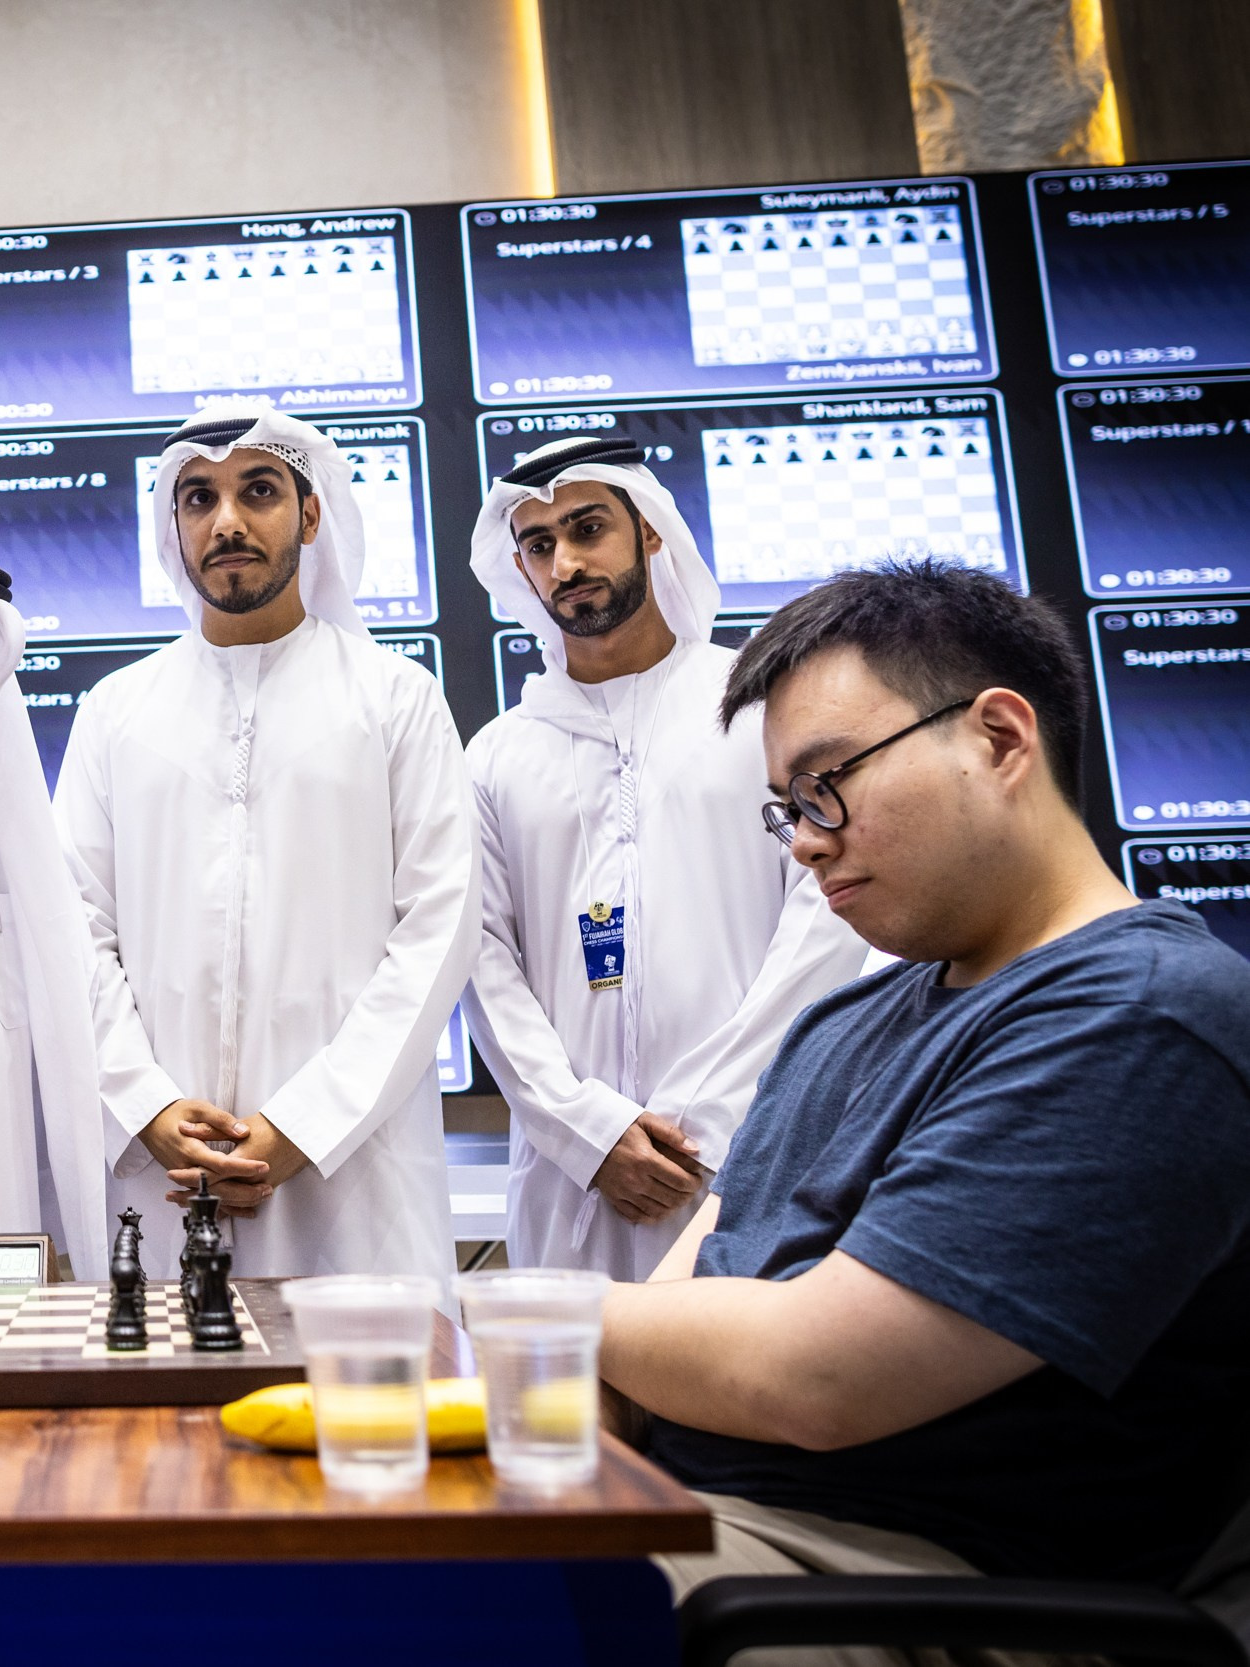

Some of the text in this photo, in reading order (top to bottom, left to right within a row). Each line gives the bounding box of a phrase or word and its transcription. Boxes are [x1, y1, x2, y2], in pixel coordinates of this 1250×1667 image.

[1069, 172, 1169, 191] 01:30:30
[894, 185, 959, 203] Aydin
[501, 204, 596, 223] 01:30:30
[1067, 207, 1193, 227] Superstars
[1212, 203, 1229, 218] 5
[242, 216, 396, 241] Hong, Andrew
[497, 237, 619, 258] Superstars
[635, 235, 652, 251] 4
[84, 266, 98, 280] 3
[1094, 346, 1197, 365] 01:30:30
[932, 358, 982, 373] Ivan
[514, 374, 612, 392] 01:30:30
[280, 388, 407, 405] Abhimanyu
[1100, 386, 1202, 405] 01:30:30
[802, 397, 987, 419] Shankland, Sam
[518, 413, 615, 432] 01:30:30
[326, 423, 410, 441] Raunak
[1091, 422, 1220, 442] Superstars
[655, 446, 673, 462] 9
[90, 473, 107, 487] 8
[1126, 568, 1231, 586] 01:30:30
[408, 601, 423, 616] L
[1132, 609, 1238, 627] 01:30:30
[1161, 800, 1250, 818] 01:30:3
